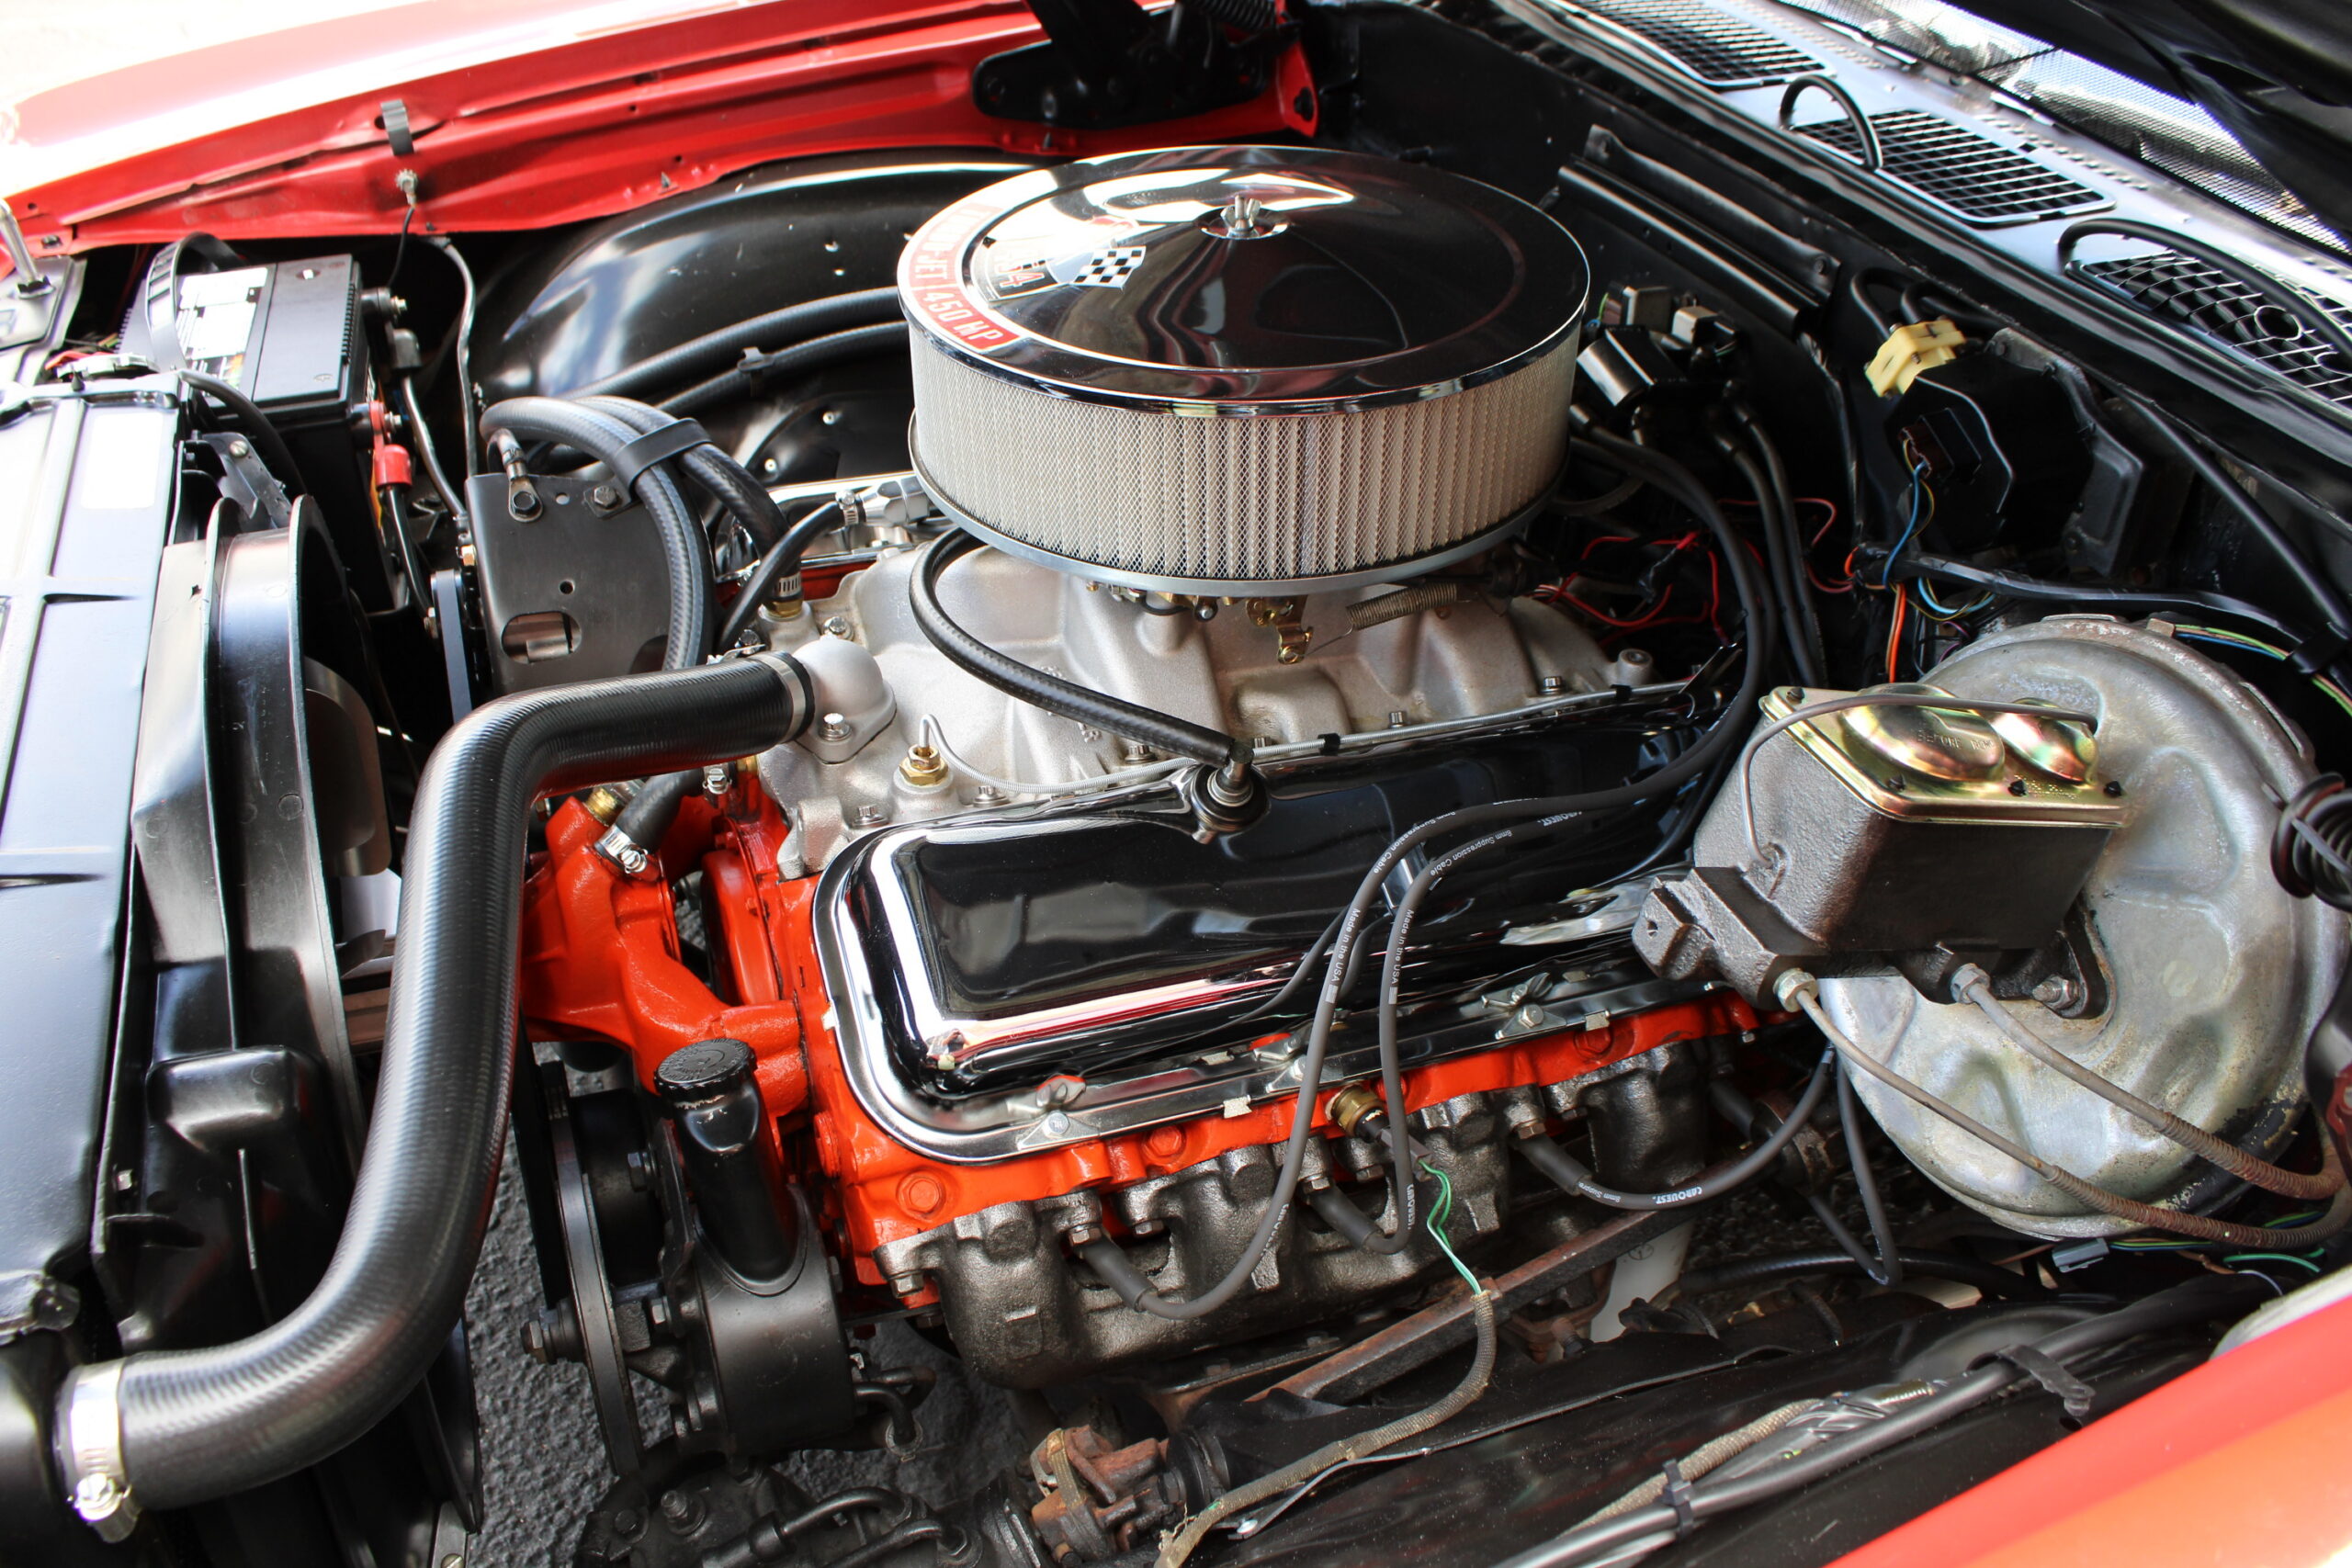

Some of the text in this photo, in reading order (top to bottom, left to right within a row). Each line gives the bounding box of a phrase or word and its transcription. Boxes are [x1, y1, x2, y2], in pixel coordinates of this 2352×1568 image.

[922, 291, 974, 322] 450
[953, 321, 1004, 341] HP
[1453, 837, 1496, 861] Suppression
[1374, 852, 1393, 874] Cable
[1430, 858, 1453, 875] Cable
[1346, 908, 1361, 933] Made
[1401, 909, 1415, 934] Made
[1338, 945, 1350, 959] the
[1395, 947, 1404, 962] the
[1331, 962, 1343, 982] USA
[1391, 964, 1401, 985] USA
[1577, 1181, 1603, 1199] Suppre
